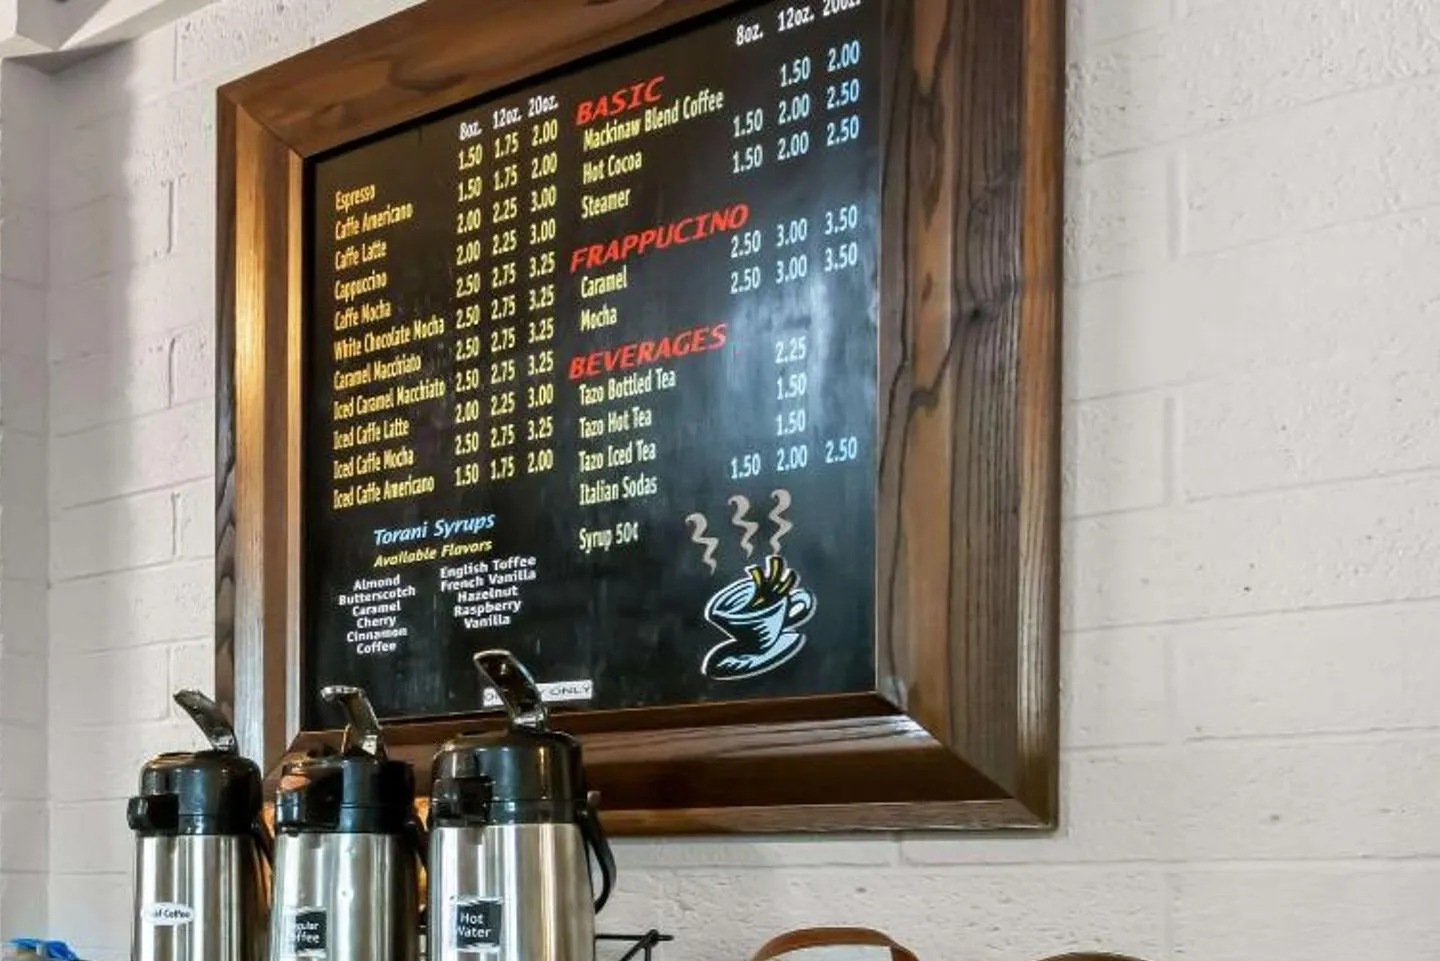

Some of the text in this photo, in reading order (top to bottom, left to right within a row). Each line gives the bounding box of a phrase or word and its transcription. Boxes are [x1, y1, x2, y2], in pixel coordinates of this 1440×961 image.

[736, 23, 764, 46] 8oz.
[778, 6, 814, 32] 12oz.
[459, 95, 558, 140] 8oz. 12oz. 20oz.
[576, 75, 664, 126] BASIC
[584, 40, 860, 152] Mackinaw Blend Coffee 1.50 2.00
[583, 78, 860, 184] Hot Cocoa 1.50 2.00 2.50
[335, 152, 558, 240] Caffe Americano 1.50 1.75 2.00
[336, 118, 558, 214] Espresso 1.50 1.75 2.00
[581, 114, 859, 219] Steamer 1.50 2.00 2.50
[335, 185, 557, 271] Caffe Latte 2.00 2.25 3.00
[570, 202, 750, 274] FRAPPUCINO
[581, 204, 858, 298] Caramel 2.50 3.00 3.50
[335, 218, 556, 302] Cappuccino 2.00 2.25 3.00
[580, 242, 858, 332] Mocha 2.50 3.00 3.50
[334, 284, 554, 360] White Chocolate Mocha 2.50 2.75 3.25
[335, 252, 555, 331] Caffe Mocha 2.50 2.75 3.25
[334, 318, 554, 390] Caramel Macchiato 2.50 2.75 3.25
[568, 323, 728, 380] BEVERAGES
[579, 336, 806, 406] Tazo Bottled Tea 2.25
[334, 350, 554, 420] Iced Caramel Macchiato 2.50 2.75 3.25
[579, 372, 806, 438] Tazo Hot Tea 1.50
[334, 384, 554, 450] Iced Caffe Latte 2.00 2.25 3.00
[579, 408, 806, 472] Tazo Iced Tea 1.50
[334, 416, 553, 480] Iced Caffe Mocha 2.50 2.75 3.25
[580, 436, 857, 506] Italian Sodas 1.50 2.00 2.50
[333, 449, 554, 510] Iced Caffe Americano 1.50 1.75 2.00
[374, 514, 496, 545] Torani Syrups
[374, 539, 493, 568] Available Flavors
[579, 527, 612, 554] Syrup
[339, 585, 416, 606] Butterscotch
[353, 574, 400, 592] Almond
[440, 554, 536, 579] English Toffee
[440, 568, 536, 592] French Vanilla
[458, 585, 519, 603] Hazelnut
[346, 627, 408, 642] Cinnamon
[352, 600, 401, 617] Caramel
[356, 614, 396, 629] Cherry
[454, 600, 522, 618] Raspberry
[464, 613, 510, 629] Vanilla
[356, 641, 396, 655] Coffee
[548, 683, 590, 696] ONLY
[460, 911, 484, 925] Hot
